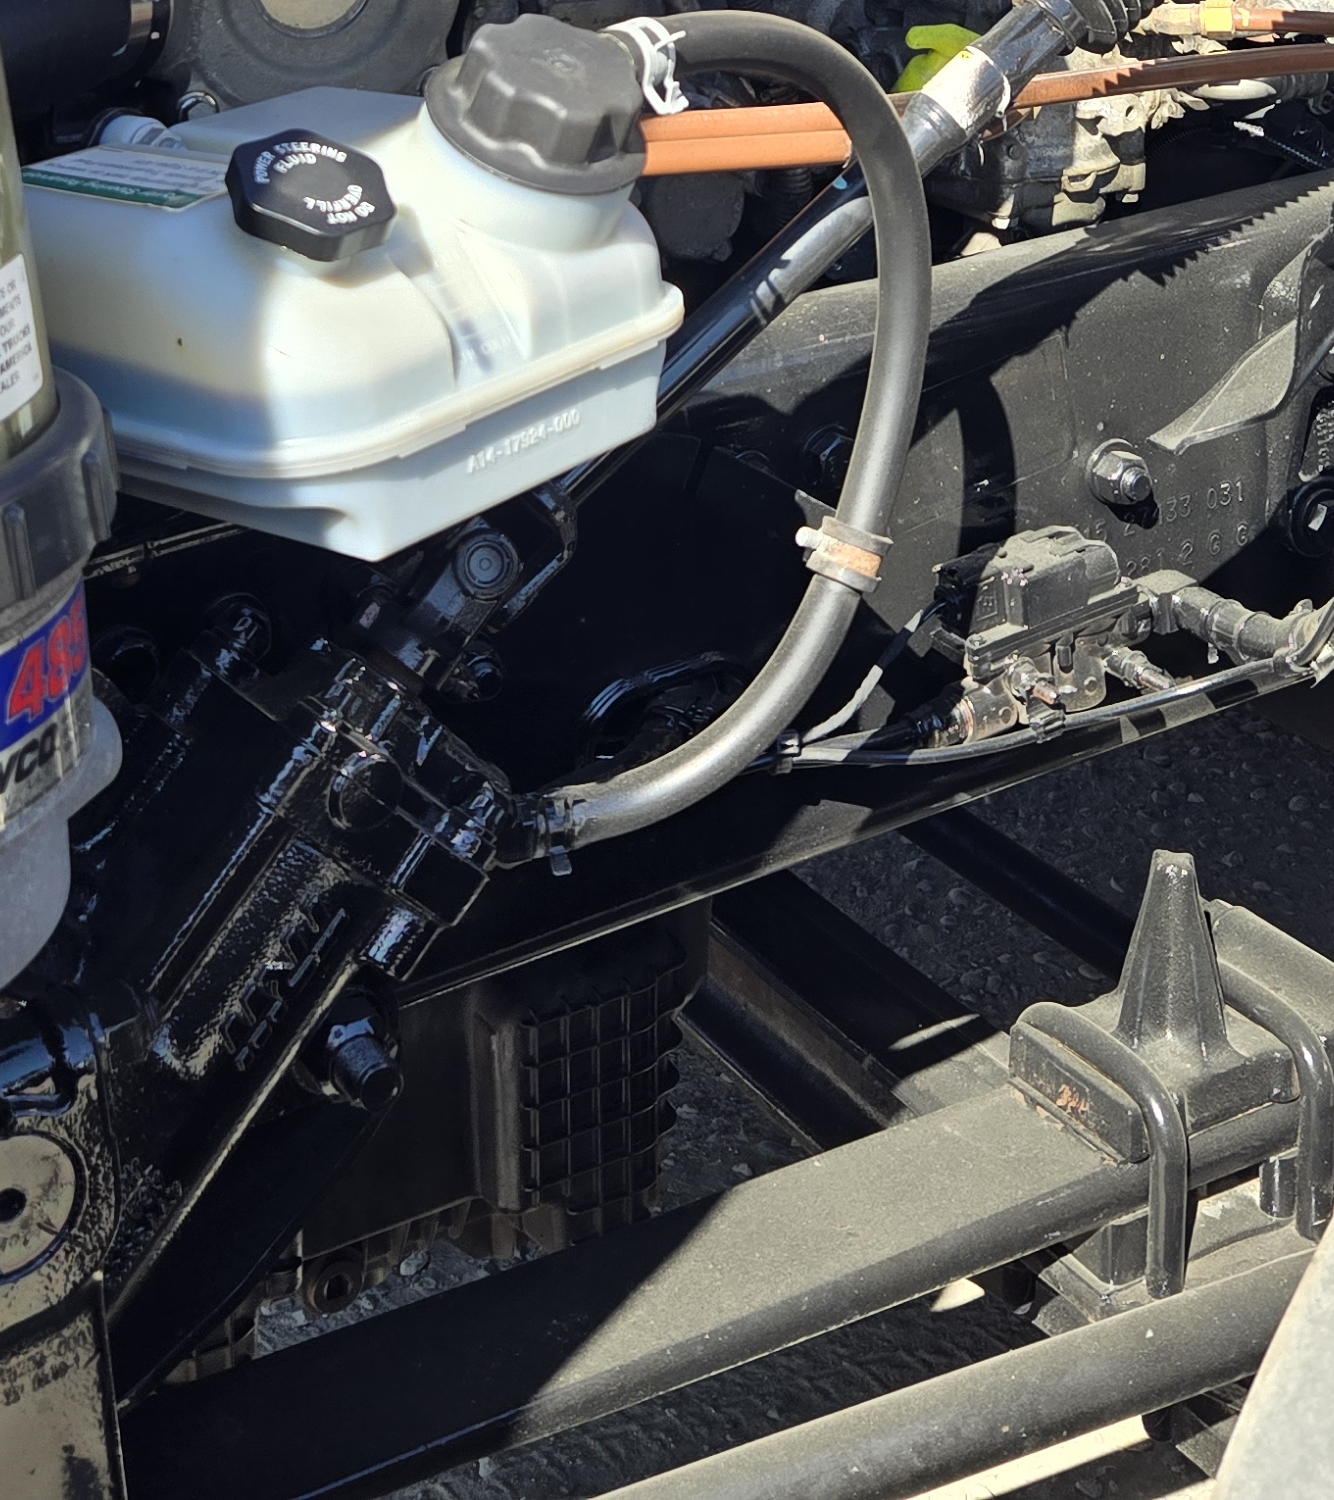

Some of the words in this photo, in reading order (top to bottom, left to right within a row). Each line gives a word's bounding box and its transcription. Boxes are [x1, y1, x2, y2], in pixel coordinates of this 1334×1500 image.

[253, 151, 275, 184] POWER
[273, 141, 347, 163] STEERING
[273, 152, 316, 174] FLUID
[303, 184, 363, 213] OVERFILL
[354, 201, 375, 217] DO
[326, 211, 358, 224] NOT
[6, 279, 17, 294] OR
[1, 324, 32, 354] TRUCKS
[0, 343, 33, 376] AMERICA
[466, 407, 581, 474] A14-17924-000
[1207, 480, 1244, 510] 031
